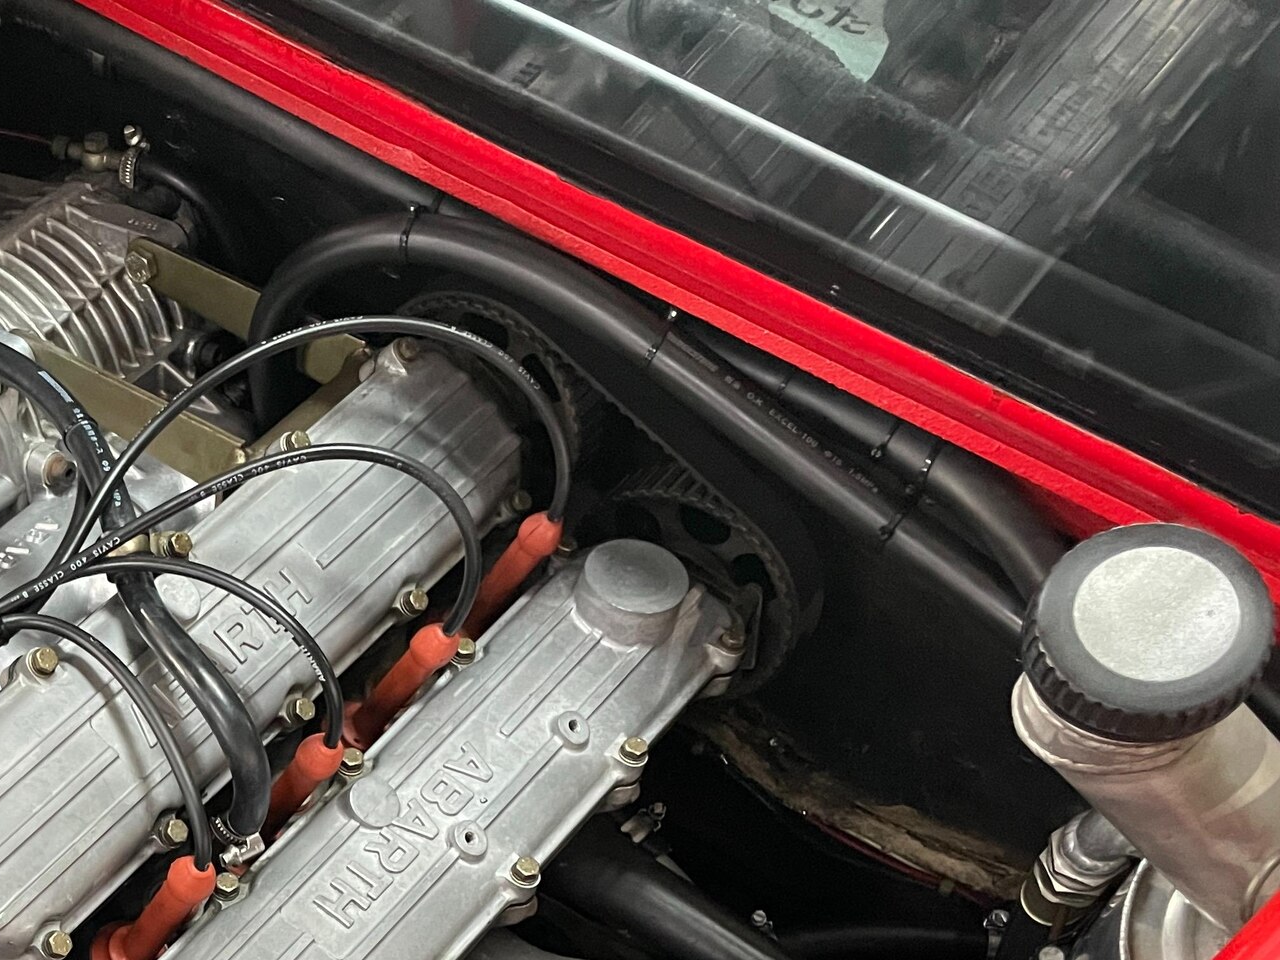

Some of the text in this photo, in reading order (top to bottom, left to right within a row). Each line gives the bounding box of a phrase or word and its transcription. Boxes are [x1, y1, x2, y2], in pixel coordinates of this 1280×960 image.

[90, 535, 122, 558] CAVIS
[68, 555, 89, 571] 400
[31, 569, 65, 592] CLASSE
[313, 741, 494, 929] ABARTH
